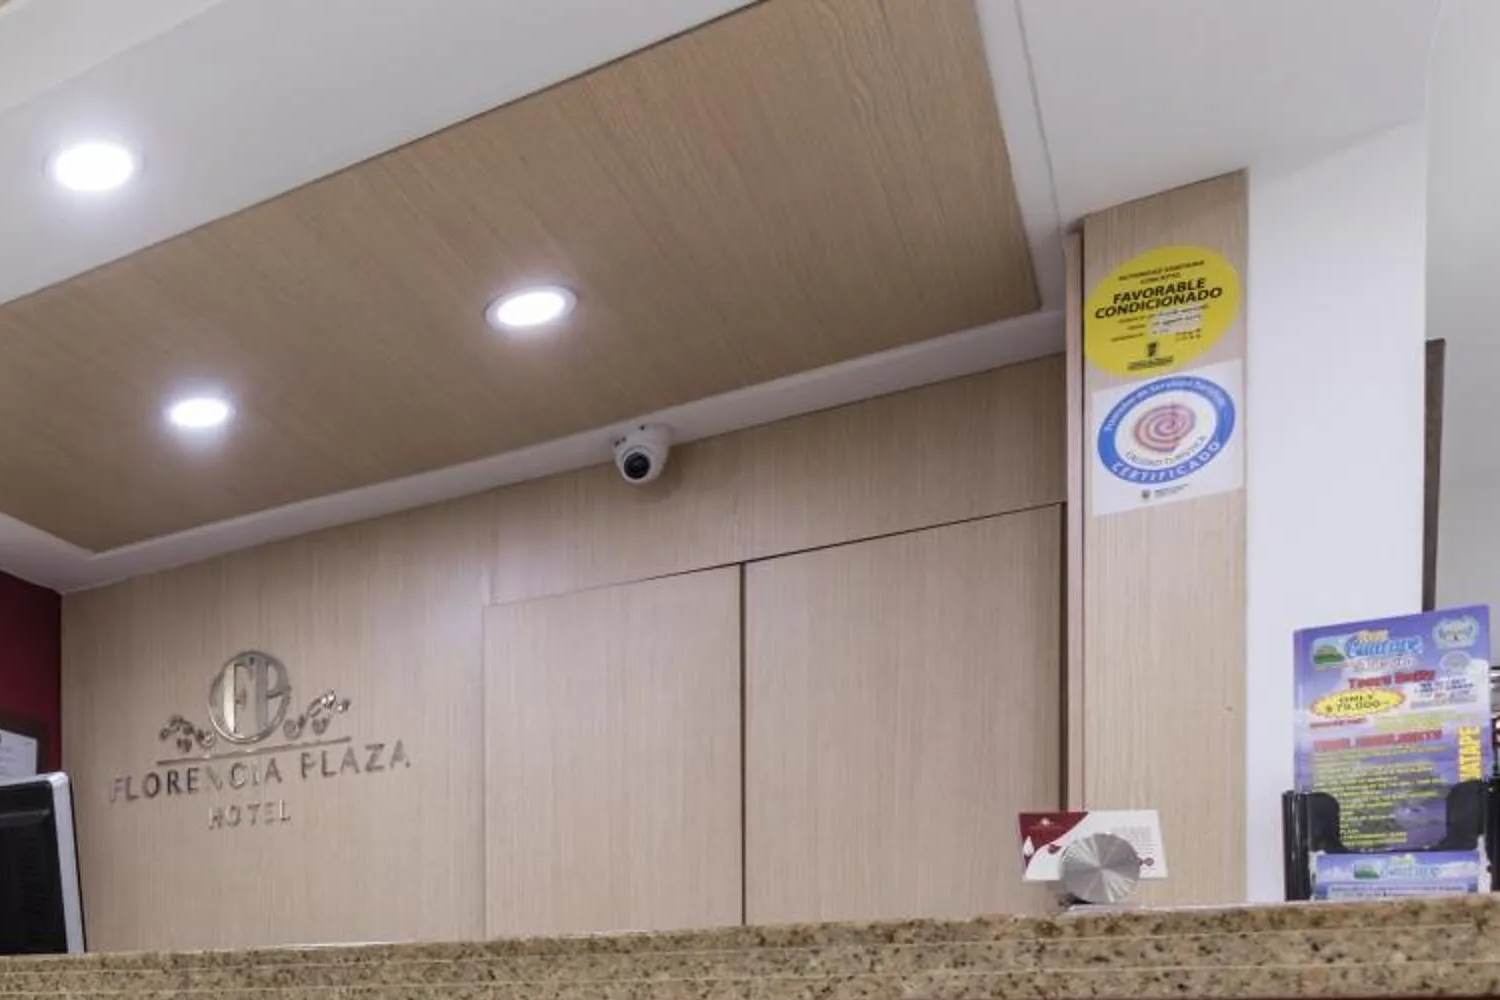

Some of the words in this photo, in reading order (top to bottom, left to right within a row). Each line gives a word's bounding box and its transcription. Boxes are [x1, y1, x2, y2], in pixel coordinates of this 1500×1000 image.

[1094, 287, 1223, 319] CONDICIONADO
[1113, 277, 1206, 304] FAVORABLE
[1111, 441, 1221, 481] CERTIFICADO
[109, 758, 282, 803] FLORENCIA
[301, 740, 410, 779] PLAZA
[209, 800, 290, 830] HOTEL
